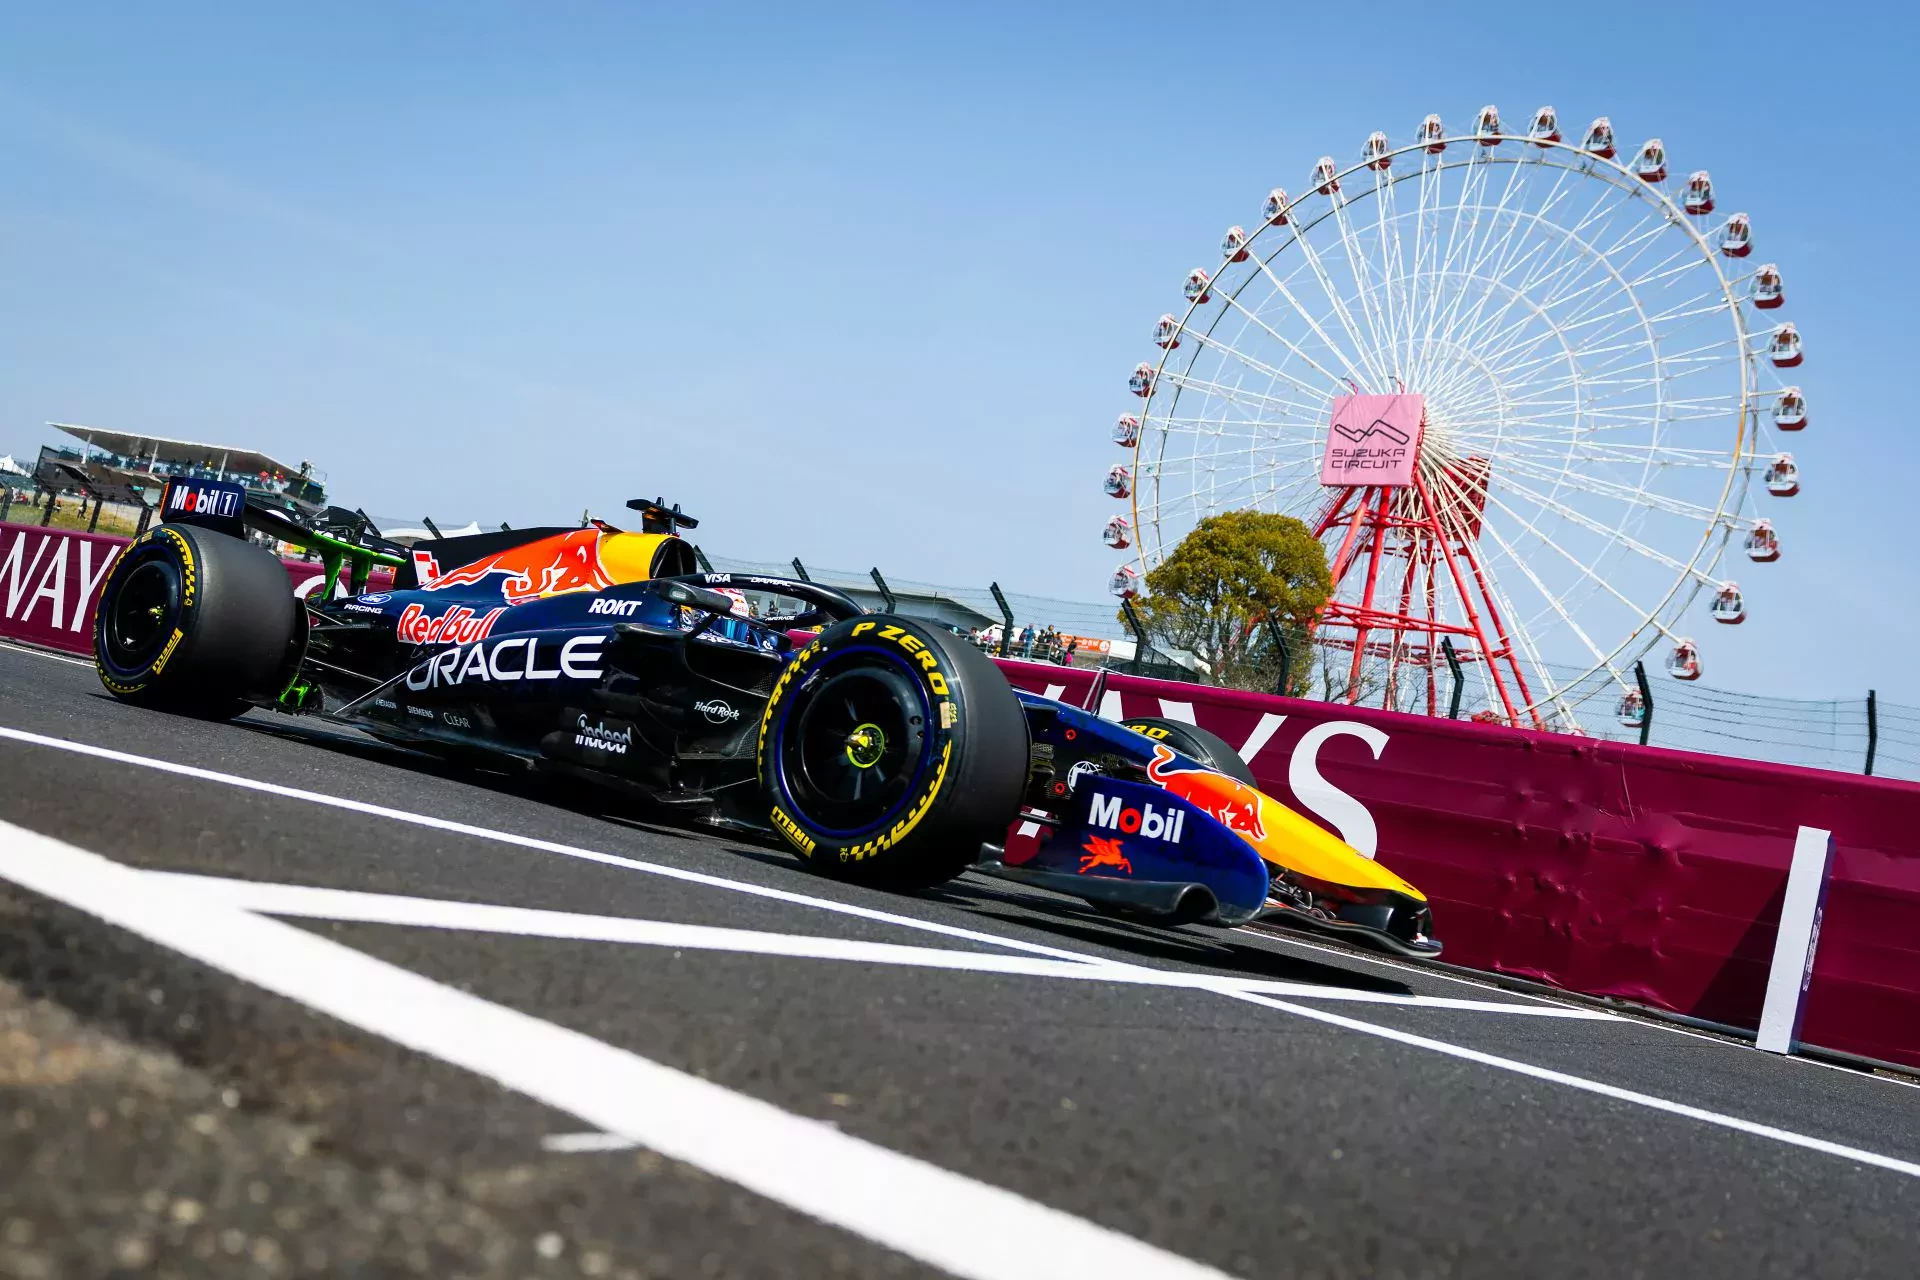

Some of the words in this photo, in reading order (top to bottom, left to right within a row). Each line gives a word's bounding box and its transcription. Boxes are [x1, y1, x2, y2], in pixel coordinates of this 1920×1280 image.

[1331, 448, 1406, 458] SUZUKA
[1331, 460, 1402, 469] CIRCUIT
[170, 485, 220, 515] Mobil
[221, 492, 236, 516] 1
[704, 573, 732, 583] VISA
[344, 603, 383, 615] RACING
[588, 598, 642, 617] ROKT
[397, 603, 461, 646] Red
[437, 605, 510, 646] Bull
[152, 627, 184, 675] PIRELLI
[850, 622, 877, 637] P
[877, 624, 950, 695] ZERO
[406, 635, 607, 692] ORACLE
[406, 705, 434, 719] SIEMENS
[443, 712, 471, 729] CLEAR
[694, 701, 718, 714] Hard
[717, 707, 740, 721] Rock
[1088, 792, 1185, 844] Mobil
[770, 806, 816, 858] PIRELLI
